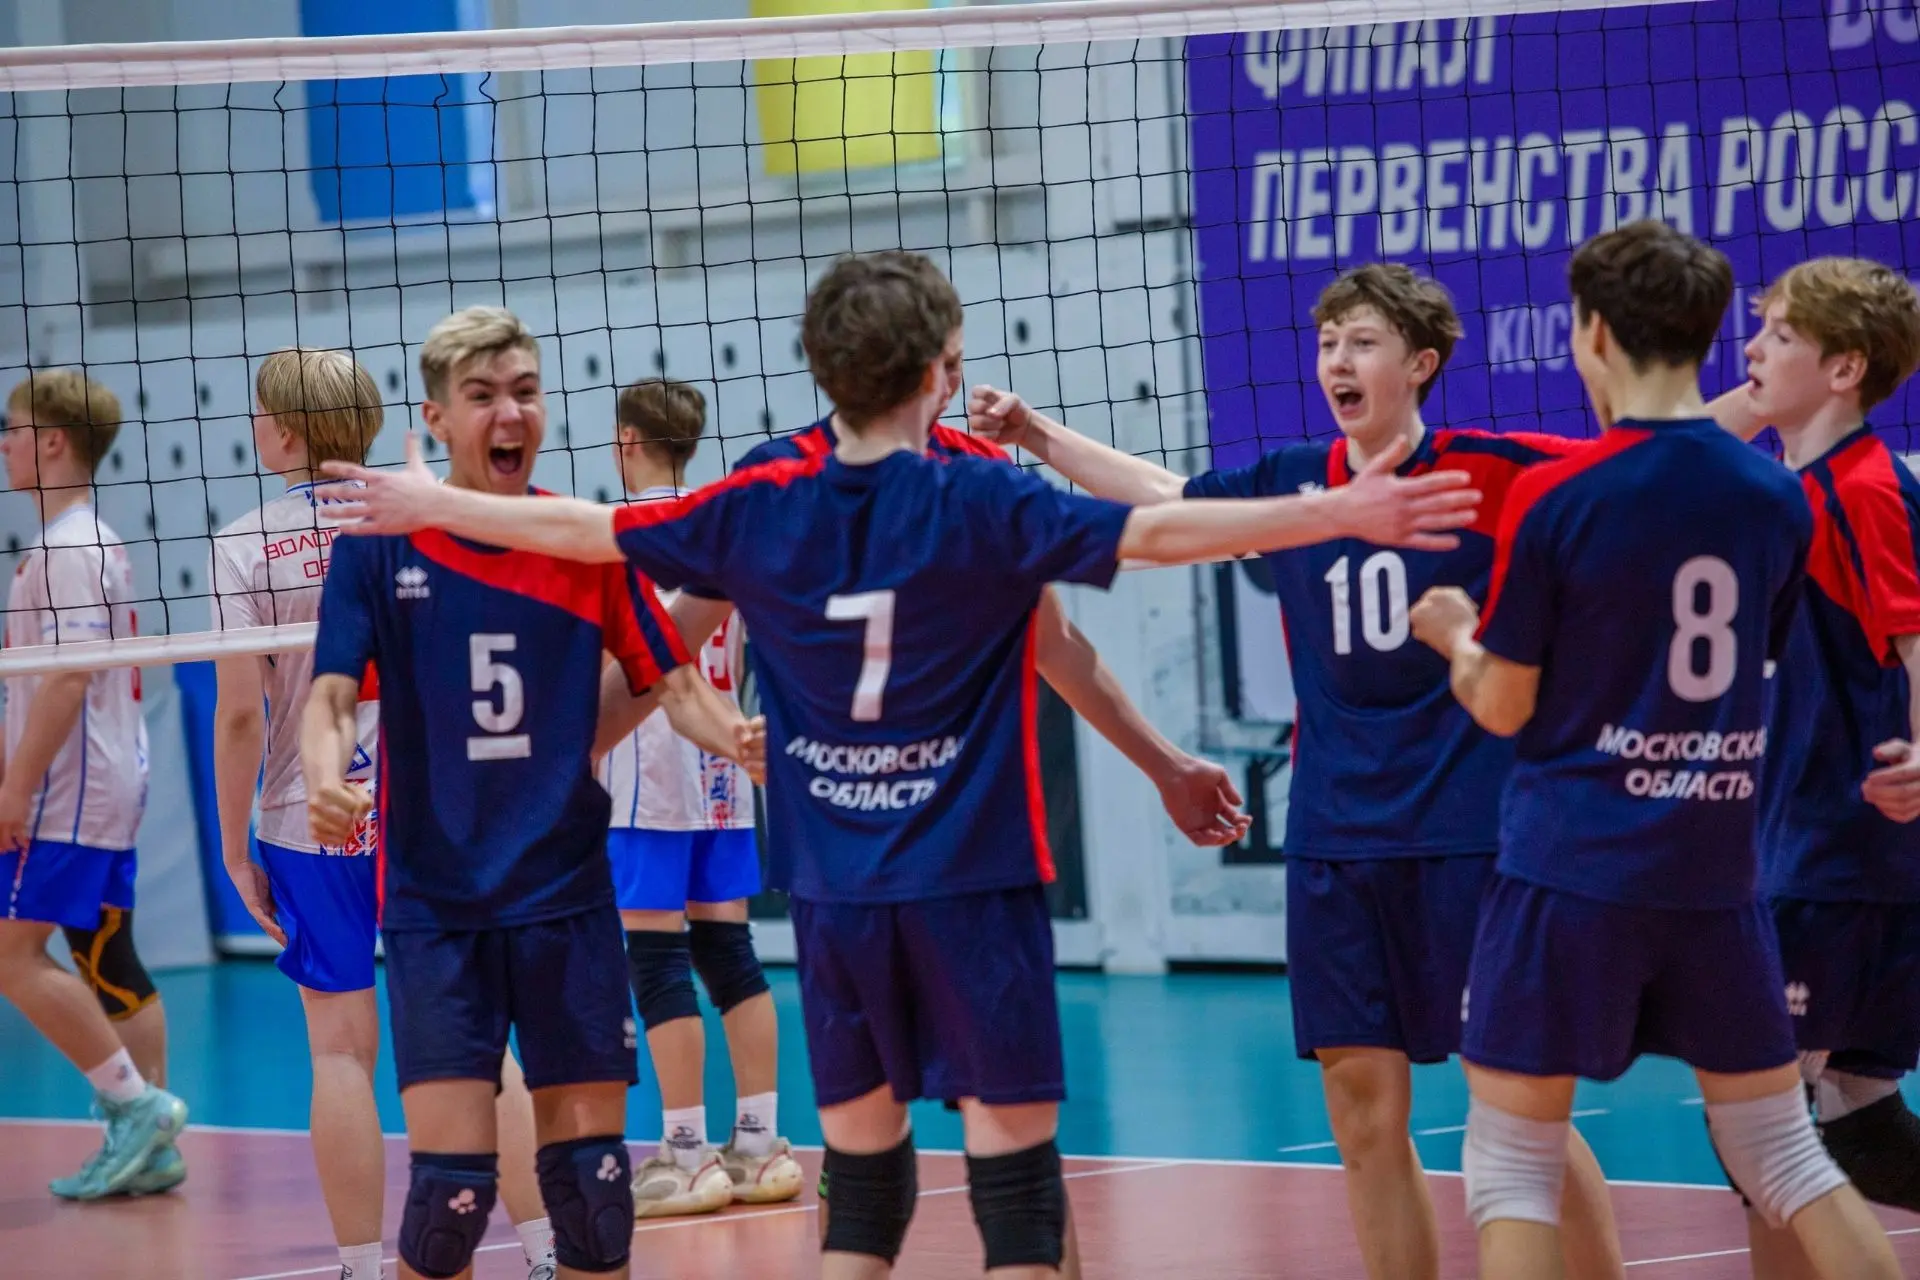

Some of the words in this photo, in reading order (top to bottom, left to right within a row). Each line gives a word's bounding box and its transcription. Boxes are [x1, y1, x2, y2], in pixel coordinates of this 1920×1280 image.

[1248, 122, 1694, 262] ПЕРВЕНСТВА
[1713, 100, 1920, 236] РОСС
[1488, 302, 1570, 374] КОС
[263, 528, 340, 561] ВОЛОГ
[1323, 550, 1409, 655] 10
[1667, 554, 1739, 702] 8
[469, 633, 524, 733] 5
[824, 589, 896, 722] 7
[785, 736, 967, 774] МОСКОВСКА
[1596, 723, 1767, 762] МОСКОВСКА
[809, 776, 938, 811] ОБЛАСТЬ
[1625, 768, 1754, 800] ОБЛАСТЬ
